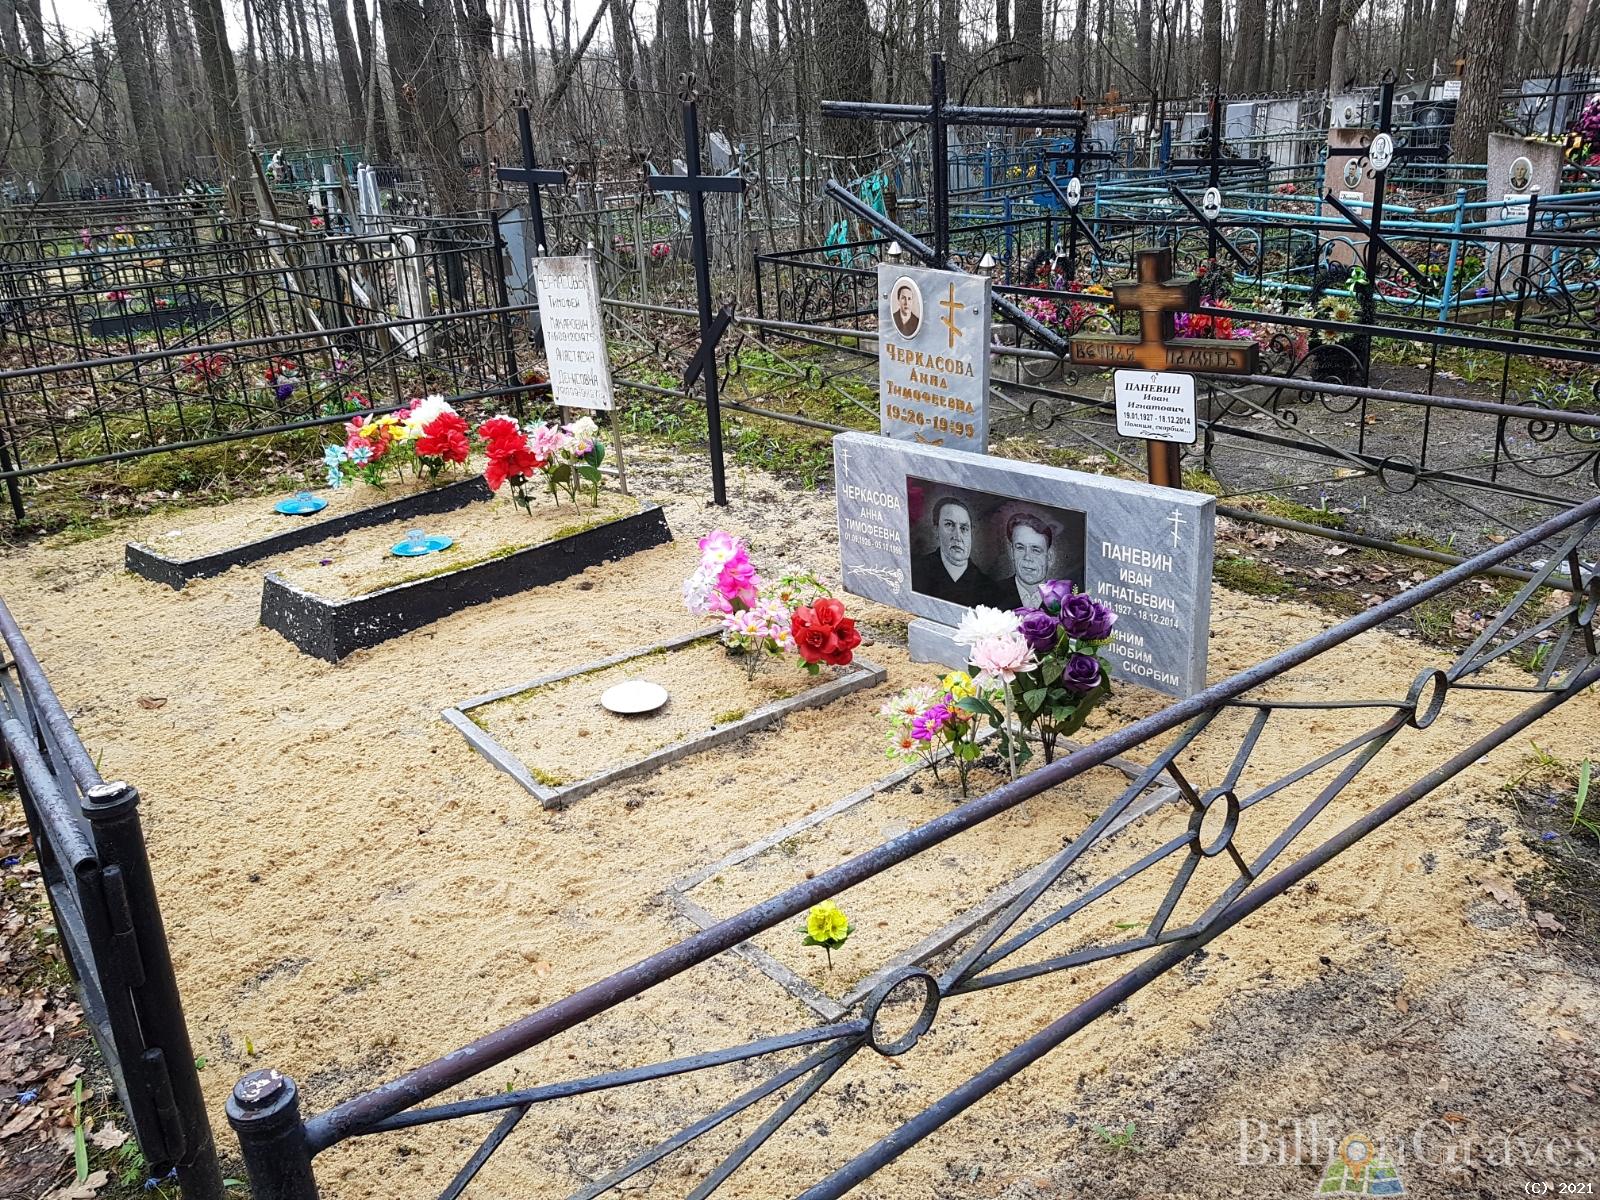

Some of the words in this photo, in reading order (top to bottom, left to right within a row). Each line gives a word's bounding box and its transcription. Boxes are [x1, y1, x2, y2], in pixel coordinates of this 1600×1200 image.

[1125, 382, 1181, 395] ПАНЕВИН
[1143, 393, 1169, 403] Иван
[1127, 401, 1184, 413] Игнатович
[1123, 411, 1154, 422] 19.01.1927
[1159, 414, 1191, 425] 18.12.2014
[842, 483, 900, 511] ЧЕРКАСОВА
[860, 507, 883, 522] АННА
[845, 518, 900, 543] ТИМОФЕЕВНА
[1102, 541, 1172, 573] ПАНЕВИН
[1119, 567, 1152, 588] ИВАН
[1097, 581, 1175, 613] ИГНАТЬЕВИЧ
[1138, 610, 1179, 629] 18.12.2014
[1108, 643, 1152, 664] ЛЮБИМ
[1122, 660, 1180, 687] СКОРБИМ
